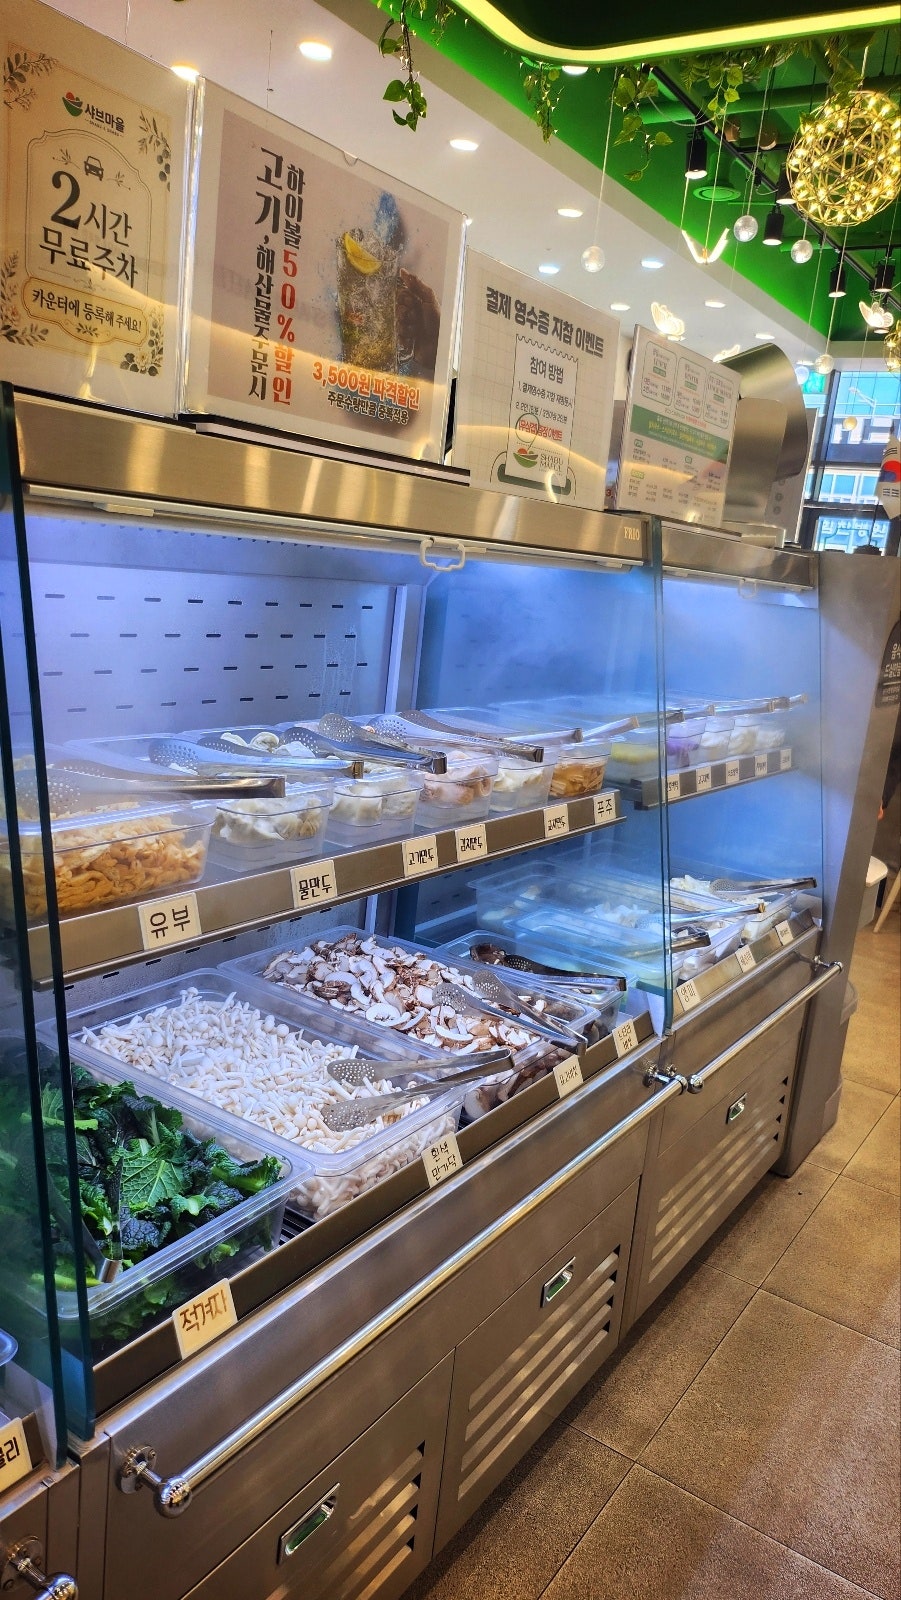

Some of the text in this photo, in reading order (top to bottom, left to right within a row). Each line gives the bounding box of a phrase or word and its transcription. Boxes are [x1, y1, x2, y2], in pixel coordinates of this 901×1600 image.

[85, 103, 125, 133] 샤브마을
[51, 170, 132, 247] 2시간
[39, 226, 138, 288] 무료주차
[32, 288, 80, 318] 카운터에
[83, 302, 115, 327] 등록해
[486, 286, 605, 359] 결제 영수증 지참 이벤트
[530, 356, 564, 384] 참여 방법
[312, 361, 420, 410] 3,500원 파격할인
[327, 390, 410, 425] 주문수량만큼 중복적용
[623, 526, 640, 540] FRIO
[597, 798, 613, 817] 푸주
[408, 848, 434, 866] 고기만두
[460, 836, 482, 852] 김치만두
[299, 874, 332, 901] 물만두
[150, 905, 190, 939] 유부
[430, 1141, 449, 1163] 흰색
[431, 1154, 457, 1181] 만가닥
[180, 1289, 228, 1331] 적겨자
